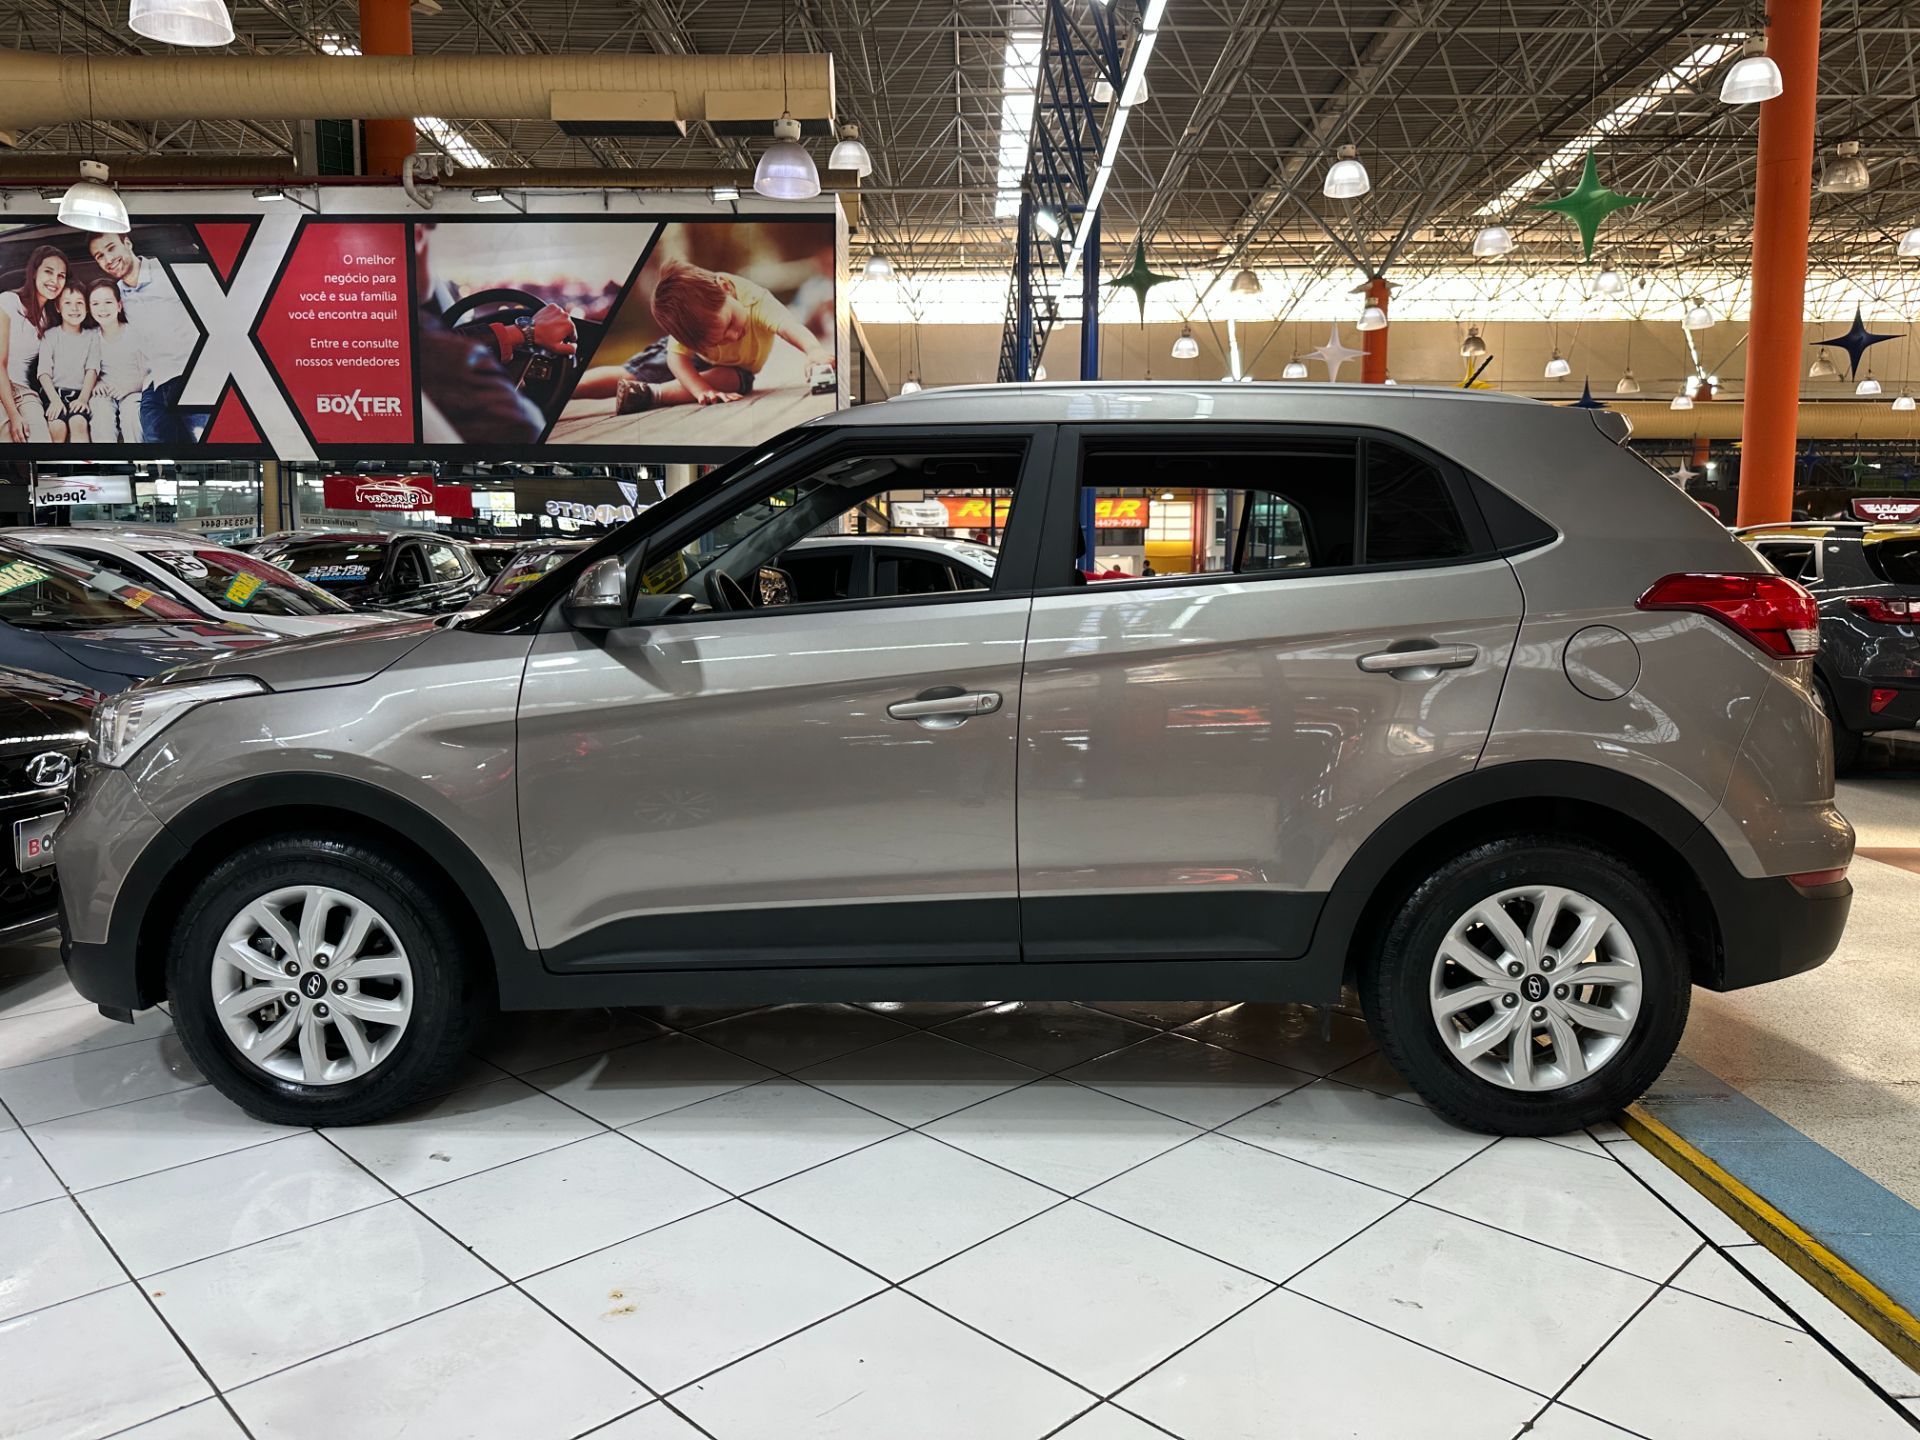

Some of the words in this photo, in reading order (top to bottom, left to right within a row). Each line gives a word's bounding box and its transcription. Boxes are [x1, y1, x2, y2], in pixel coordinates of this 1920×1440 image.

[343, 254, 353, 265] O
[356, 254, 396, 265] melhor
[324, 273, 370, 285] negócio
[372, 275, 396, 285] para
[300, 291, 326, 301] você
[329, 293, 336, 301] e
[339, 293, 358, 301] sua
[361, 291, 397, 301] família
[288, 309, 315, 319] você
[318, 311, 368, 319] encontra
[370, 309, 398, 322] aqui!
[310, 338, 339, 348] Entre
[352, 338, 399, 348] consulte
[295, 358, 333, 366] nossos
[336, 357, 400, 366] vendedores
[317, 389, 402, 421] BOXTER
